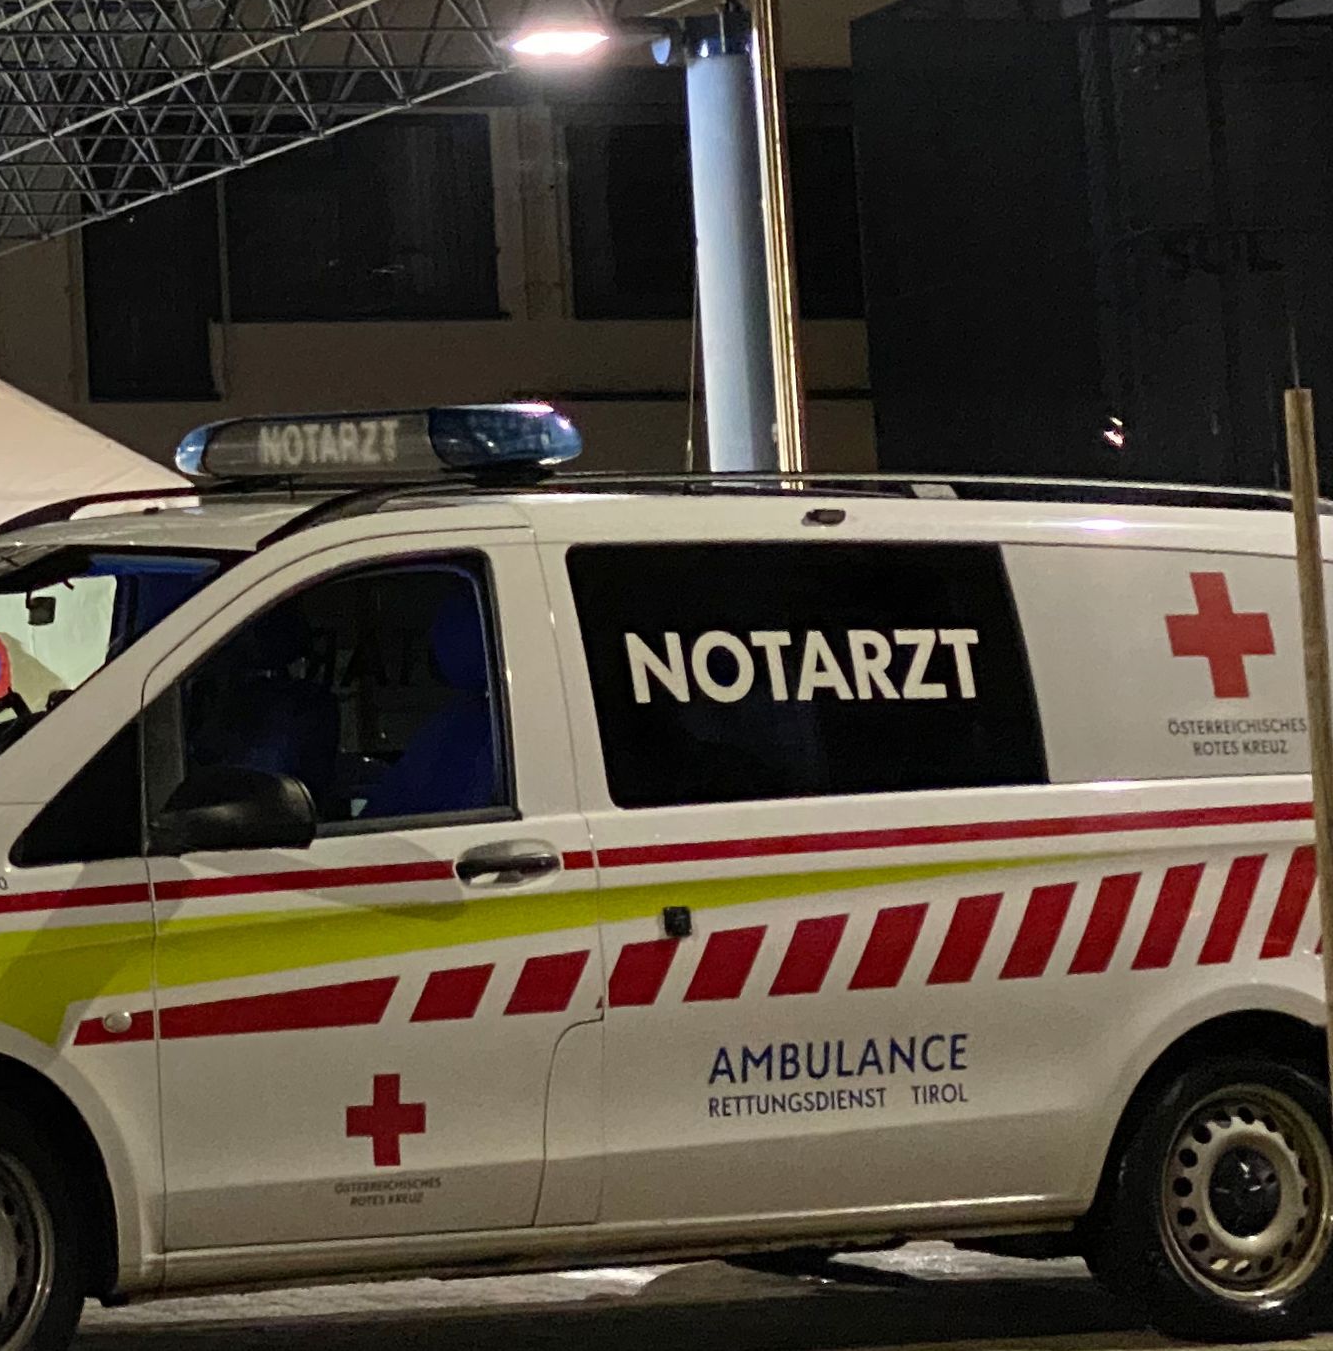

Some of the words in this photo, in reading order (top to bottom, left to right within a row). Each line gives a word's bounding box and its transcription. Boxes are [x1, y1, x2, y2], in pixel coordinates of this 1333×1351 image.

[259, 419, 399, 465] NOTARZT
[625, 629, 979, 703] NOTARZT
[1193, 740, 1239, 756] ROTES
[1242, 739, 1290, 755] KREUZ
[708, 1033, 969, 1085] AMBULANCE
[708, 1088, 887, 1118] RETTUNGSDIENST
[911, 1083, 969, 1105] TIROL
